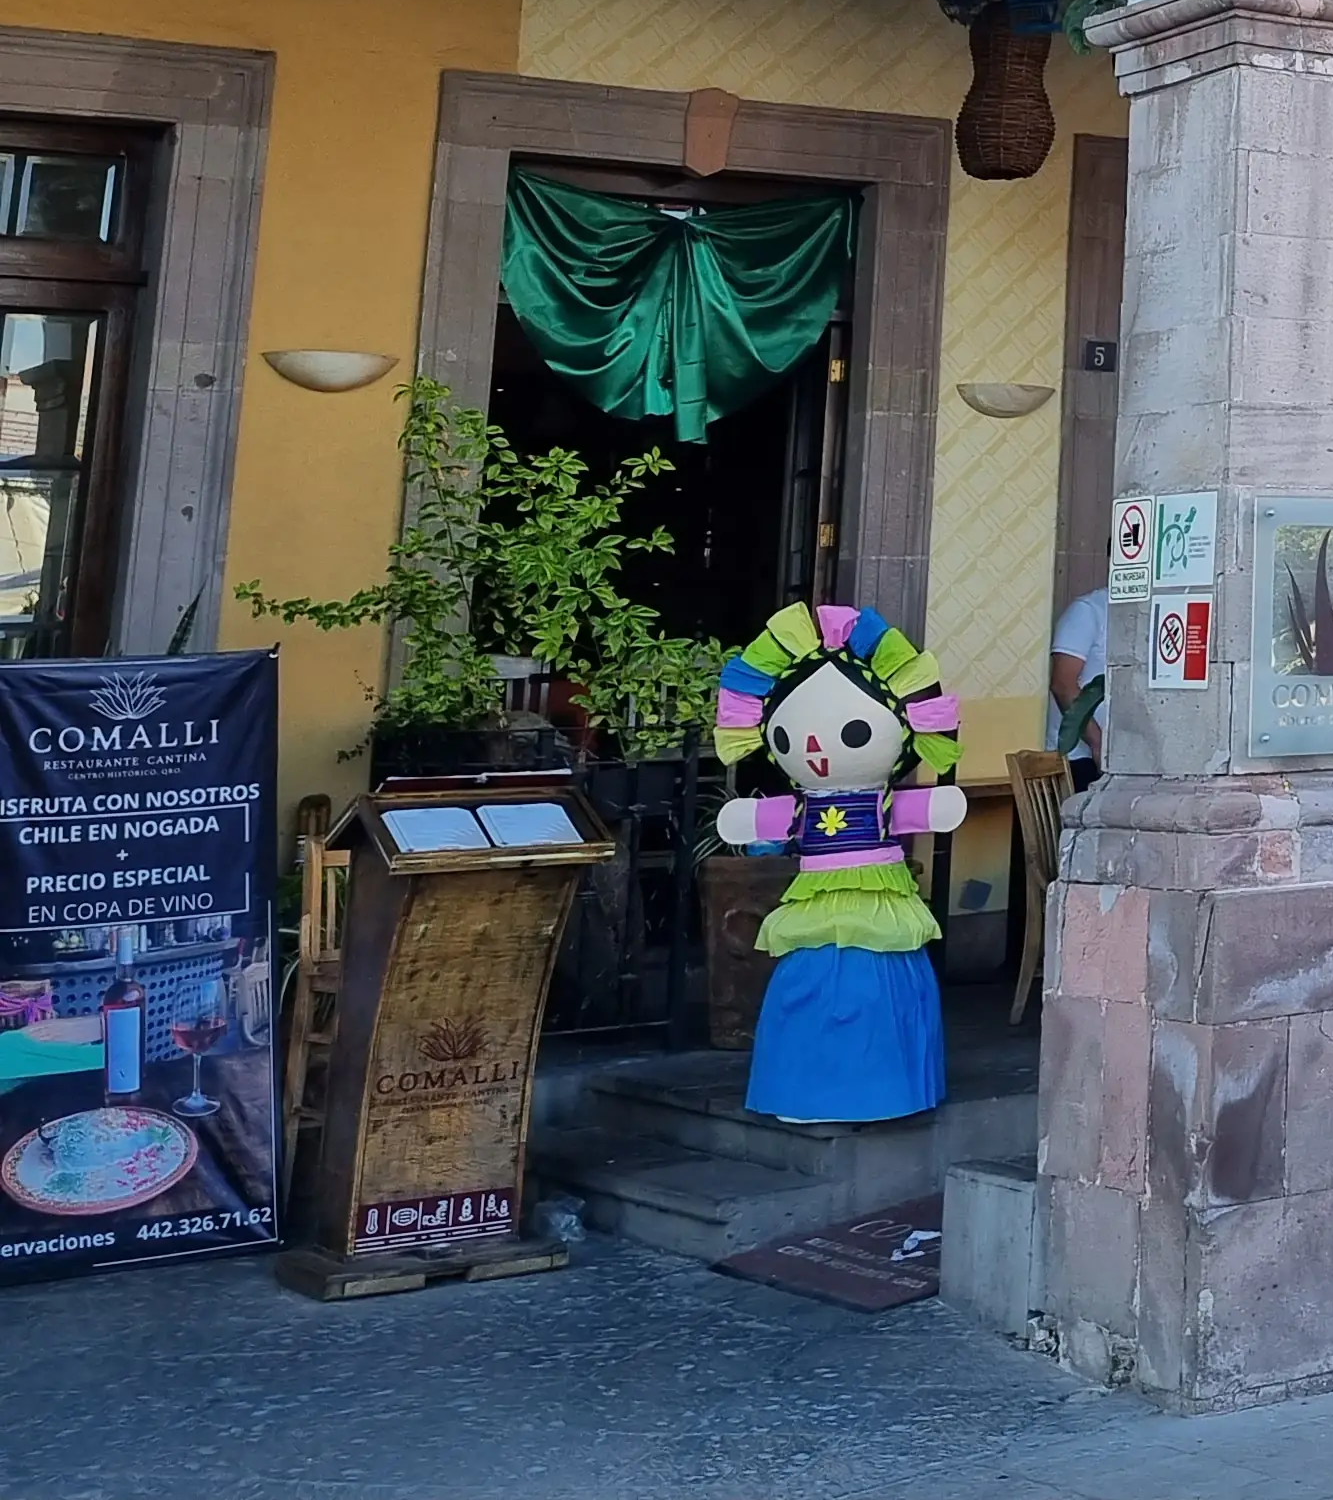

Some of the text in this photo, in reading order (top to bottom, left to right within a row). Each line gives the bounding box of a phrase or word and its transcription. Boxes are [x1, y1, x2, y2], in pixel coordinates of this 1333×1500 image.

[1094, 346, 1106, 367] 5
[29, 719, 220, 754] COMALLI
[43, 752, 207, 771] RESTAURANTE CANTINA
[0, 783, 260, 816] ISFRUTA CON NOSOTROS
[19, 815, 220, 845] CHILE EN NOGADA
[26, 864, 211, 894] PRECIO ESPECIAL
[28, 892, 214, 924] EN COPA DE VINO
[376, 1061, 520, 1094] COMALLI
[0, 1206, 272, 1258] ervaciones 442.326.71.62
